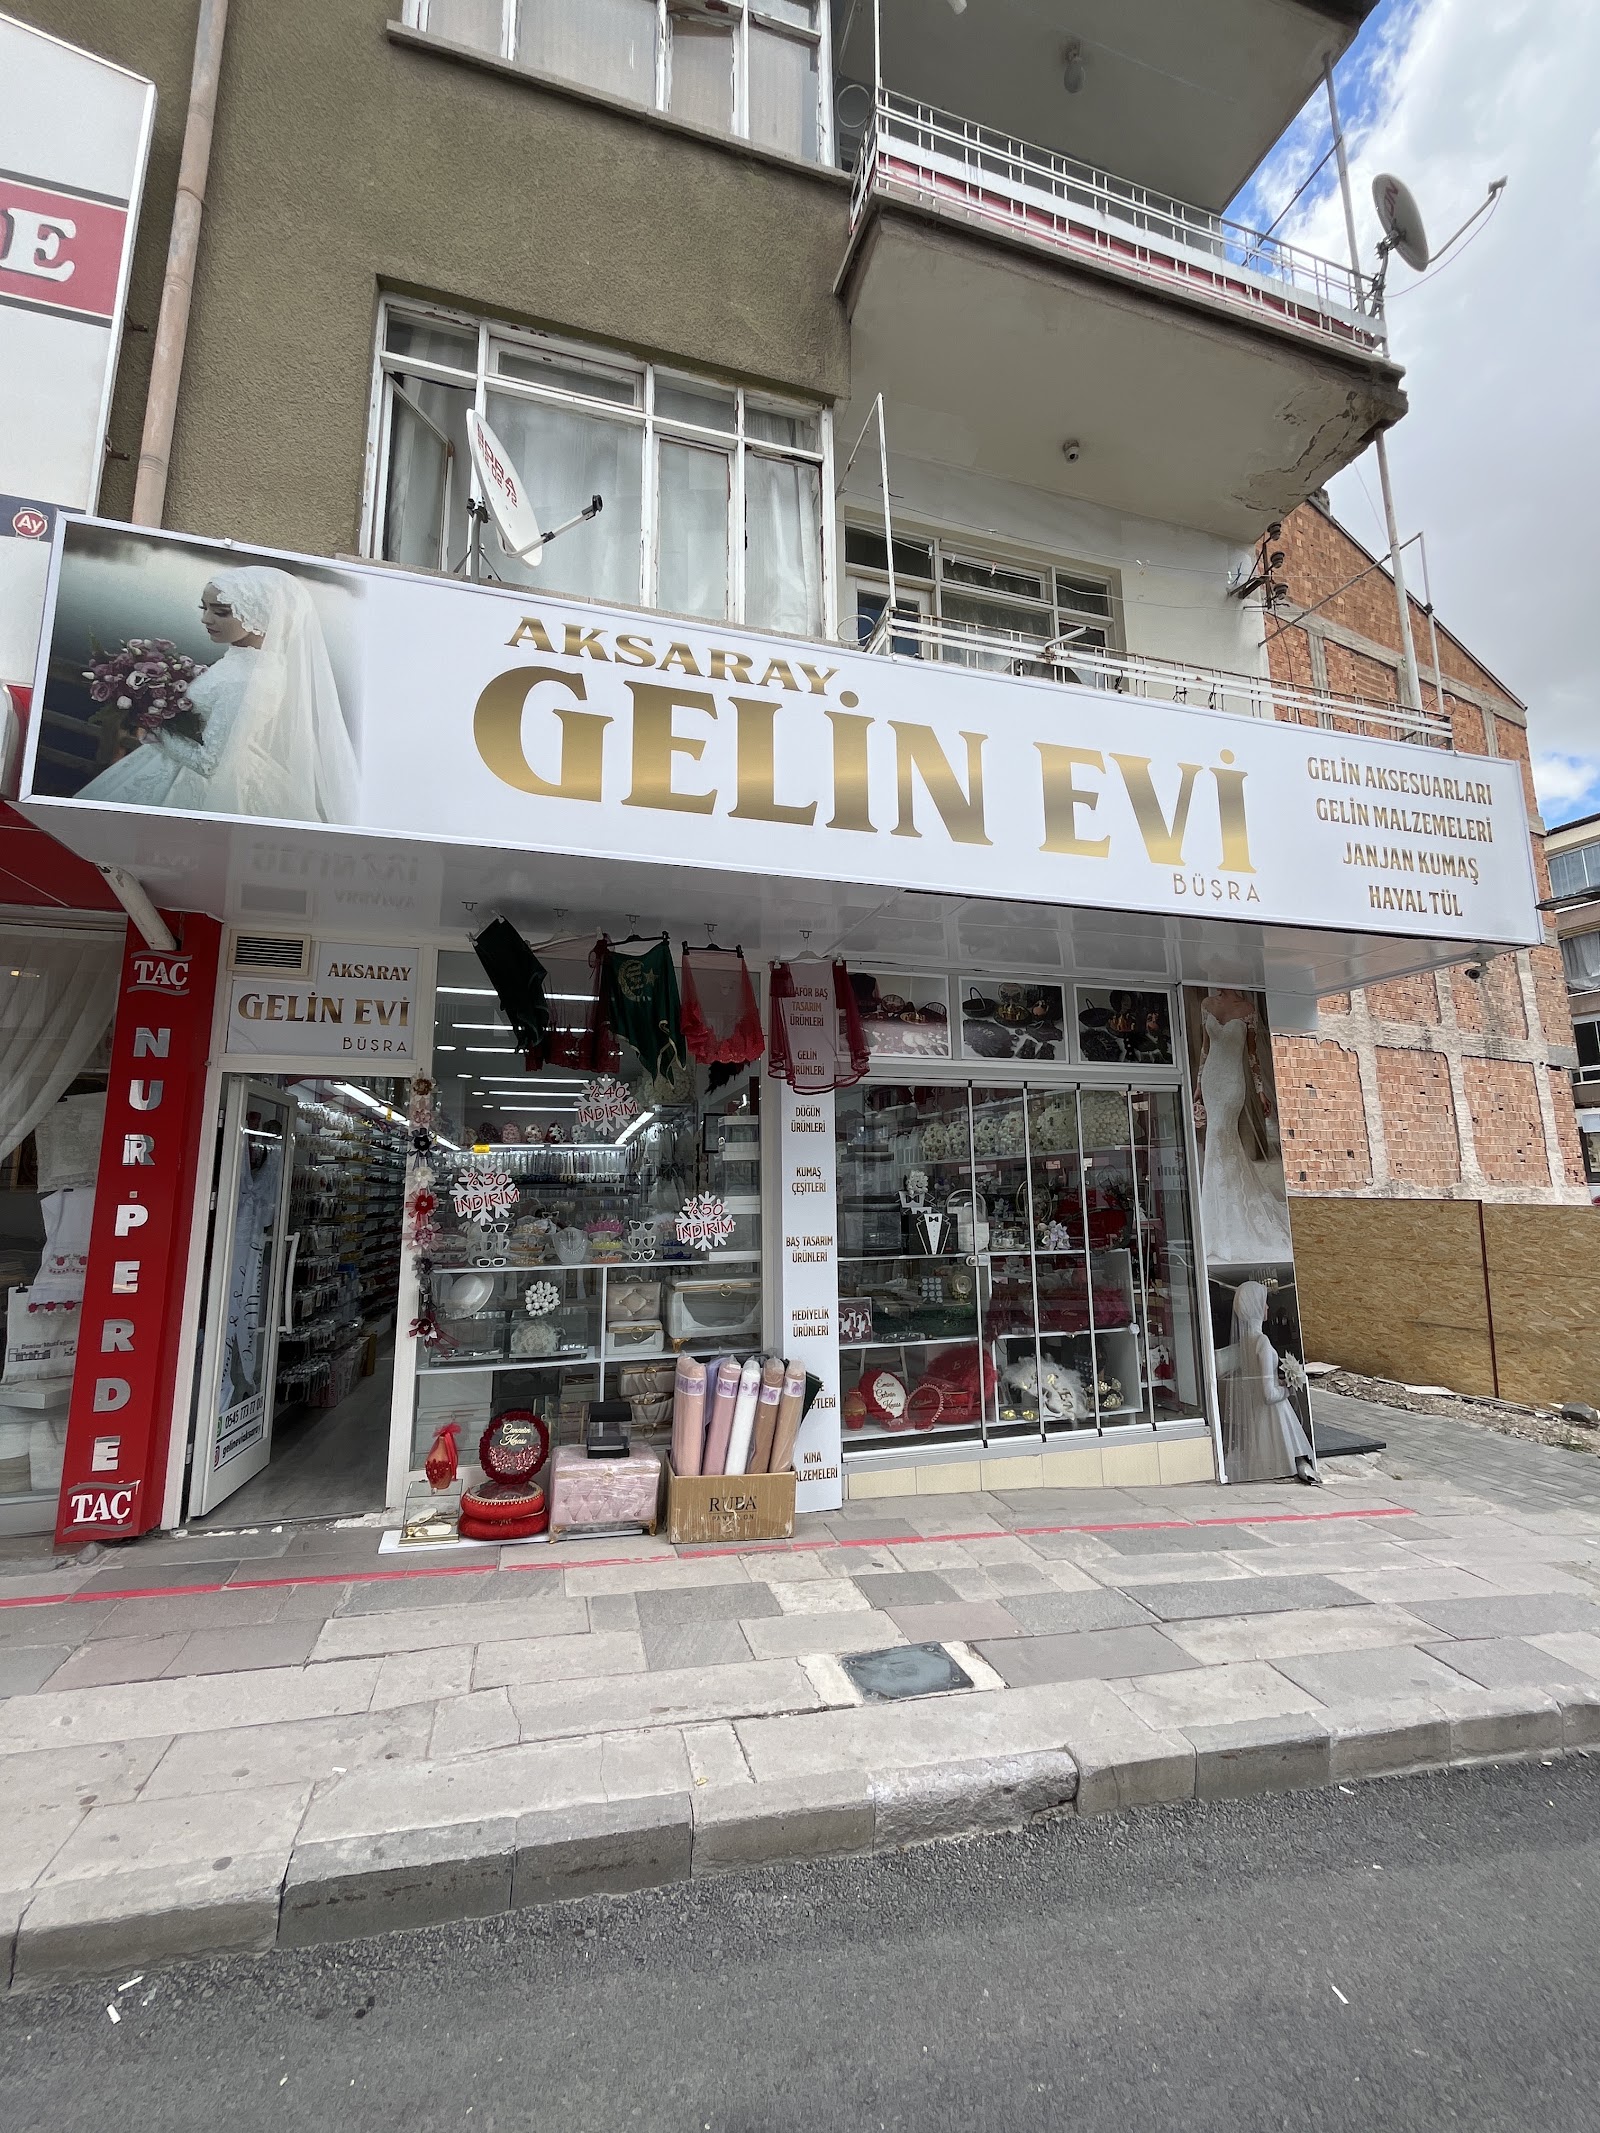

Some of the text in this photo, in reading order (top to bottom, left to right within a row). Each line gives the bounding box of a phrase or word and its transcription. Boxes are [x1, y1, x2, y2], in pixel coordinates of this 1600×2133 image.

[18, 515, 43, 533] Ay
[504, 616, 840, 696] AKSARAY
[473, 666, 1257, 873] GELİN EVİ
[1307, 756, 1493, 806] GELİN AKSESUARLARI
[1316, 797, 1493, 843] GELİN MALZEMELERİ
[1343, 842, 1479, 885] JANJAN KUMAŞ
[1173, 873, 1261, 902] BÜŞRA
[1368, 885, 1463, 917] HAYAL TÜL
[327, 962, 412, 981] AKSARAY
[815, 988, 828, 1000] BAŞ
[237, 991, 411, 1027] GELİN EVİ
[792, 1001, 822, 1012] TASARIM
[790, 1013, 824, 1027] ÜRÜNLERİ
[342, 1036, 407, 1052] BÜŞRA
[797, 1048, 817, 1060] GELİN
[579, 1101, 637, 1122] İNDİRİM
[795, 1104, 821, 1117] DÜĞÜN
[791, 1119, 826, 1133] ÜRÜNLERİ
[796, 1166, 822, 1179] KUMAŞ
[791, 1179, 826, 1195] ÇEŞİTLERİ
[456, 1189, 519, 1212] İNDİRİM
[677, 1219, 733, 1240] İNDİRİM
[786, 1235, 833, 1249] BAŞ TASARIM
[792, 1249, 828, 1263] ÜRÜNLERİ
[792, 1306, 829, 1321] HEDİYELİK
[793, 1322, 829, 1338] ÜRÜNLERİ
[803, 1451, 822, 1463] KINA
[795, 1464, 838, 1482] ALZEMELERİ
